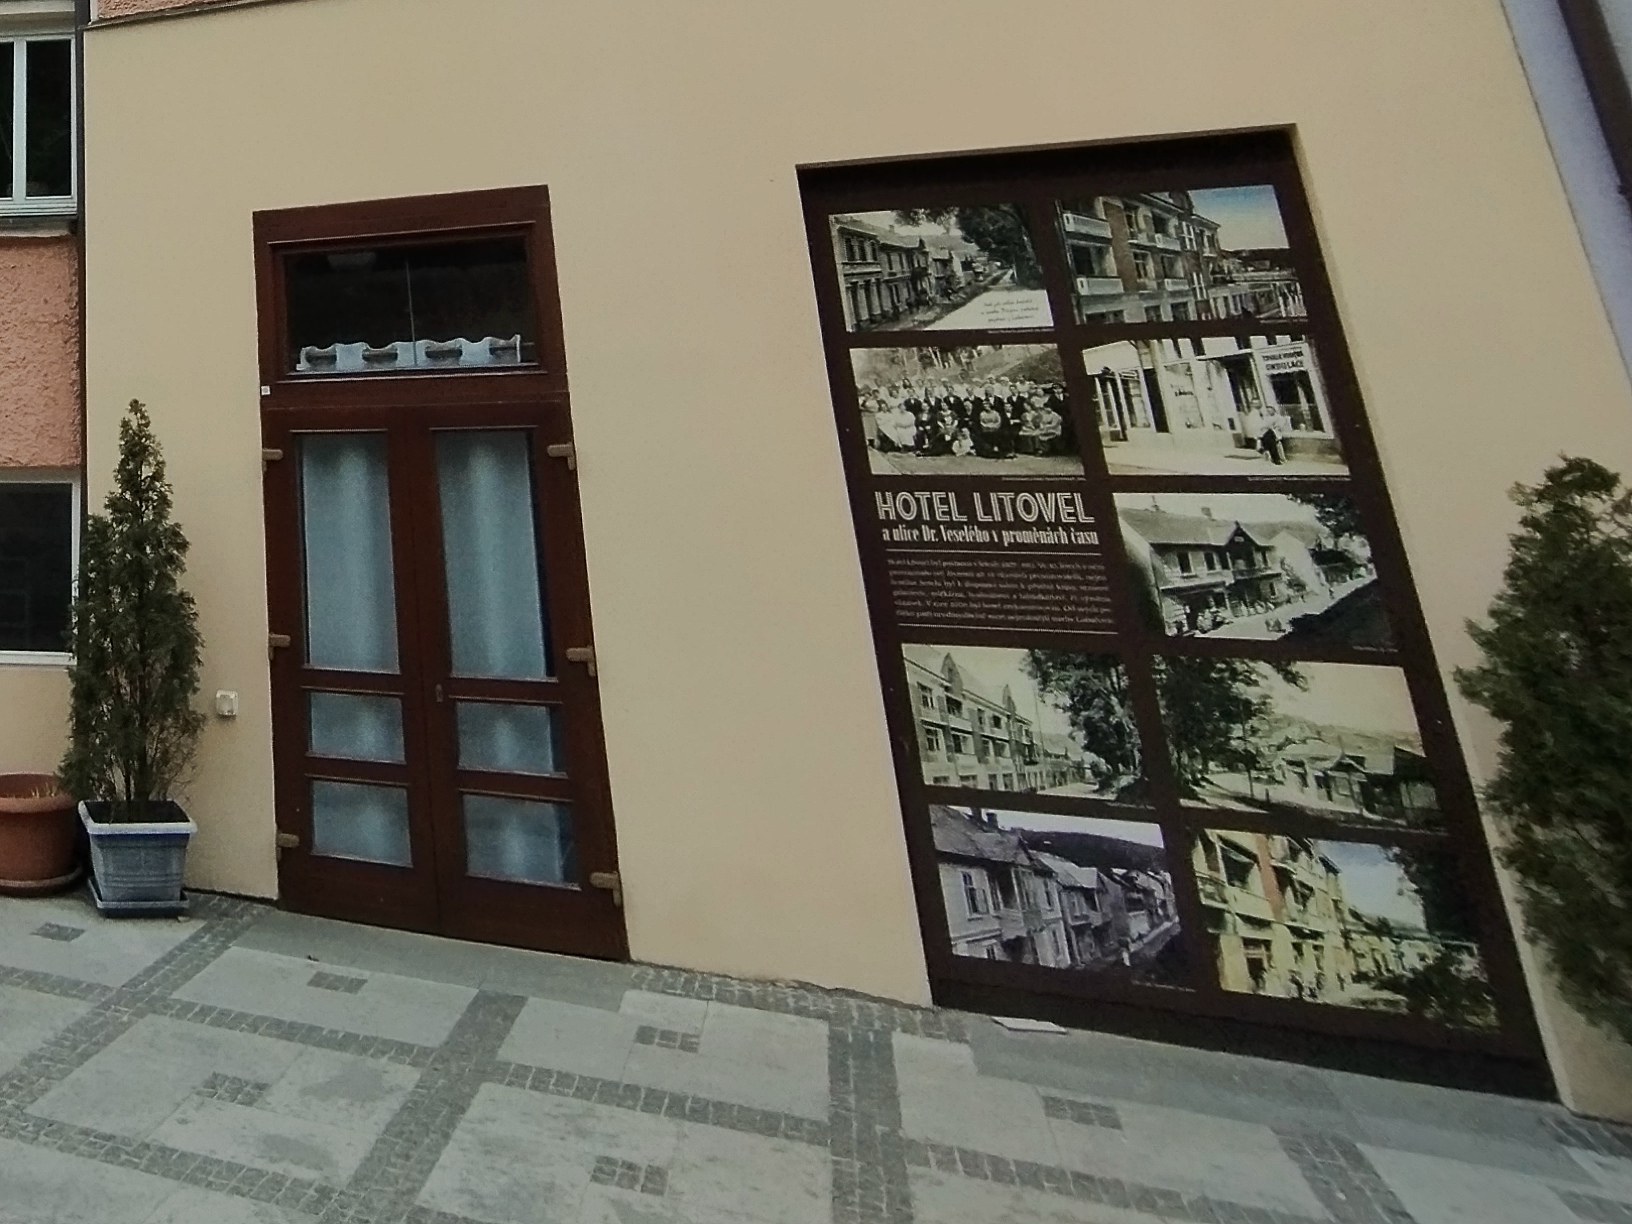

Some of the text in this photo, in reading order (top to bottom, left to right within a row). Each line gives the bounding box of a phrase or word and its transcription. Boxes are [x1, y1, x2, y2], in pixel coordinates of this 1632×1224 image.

[874, 491, 1095, 523] HOTEL LITOVEL
[882, 525, 1099, 546] a ulice Dr. Veselého v proměnách času
